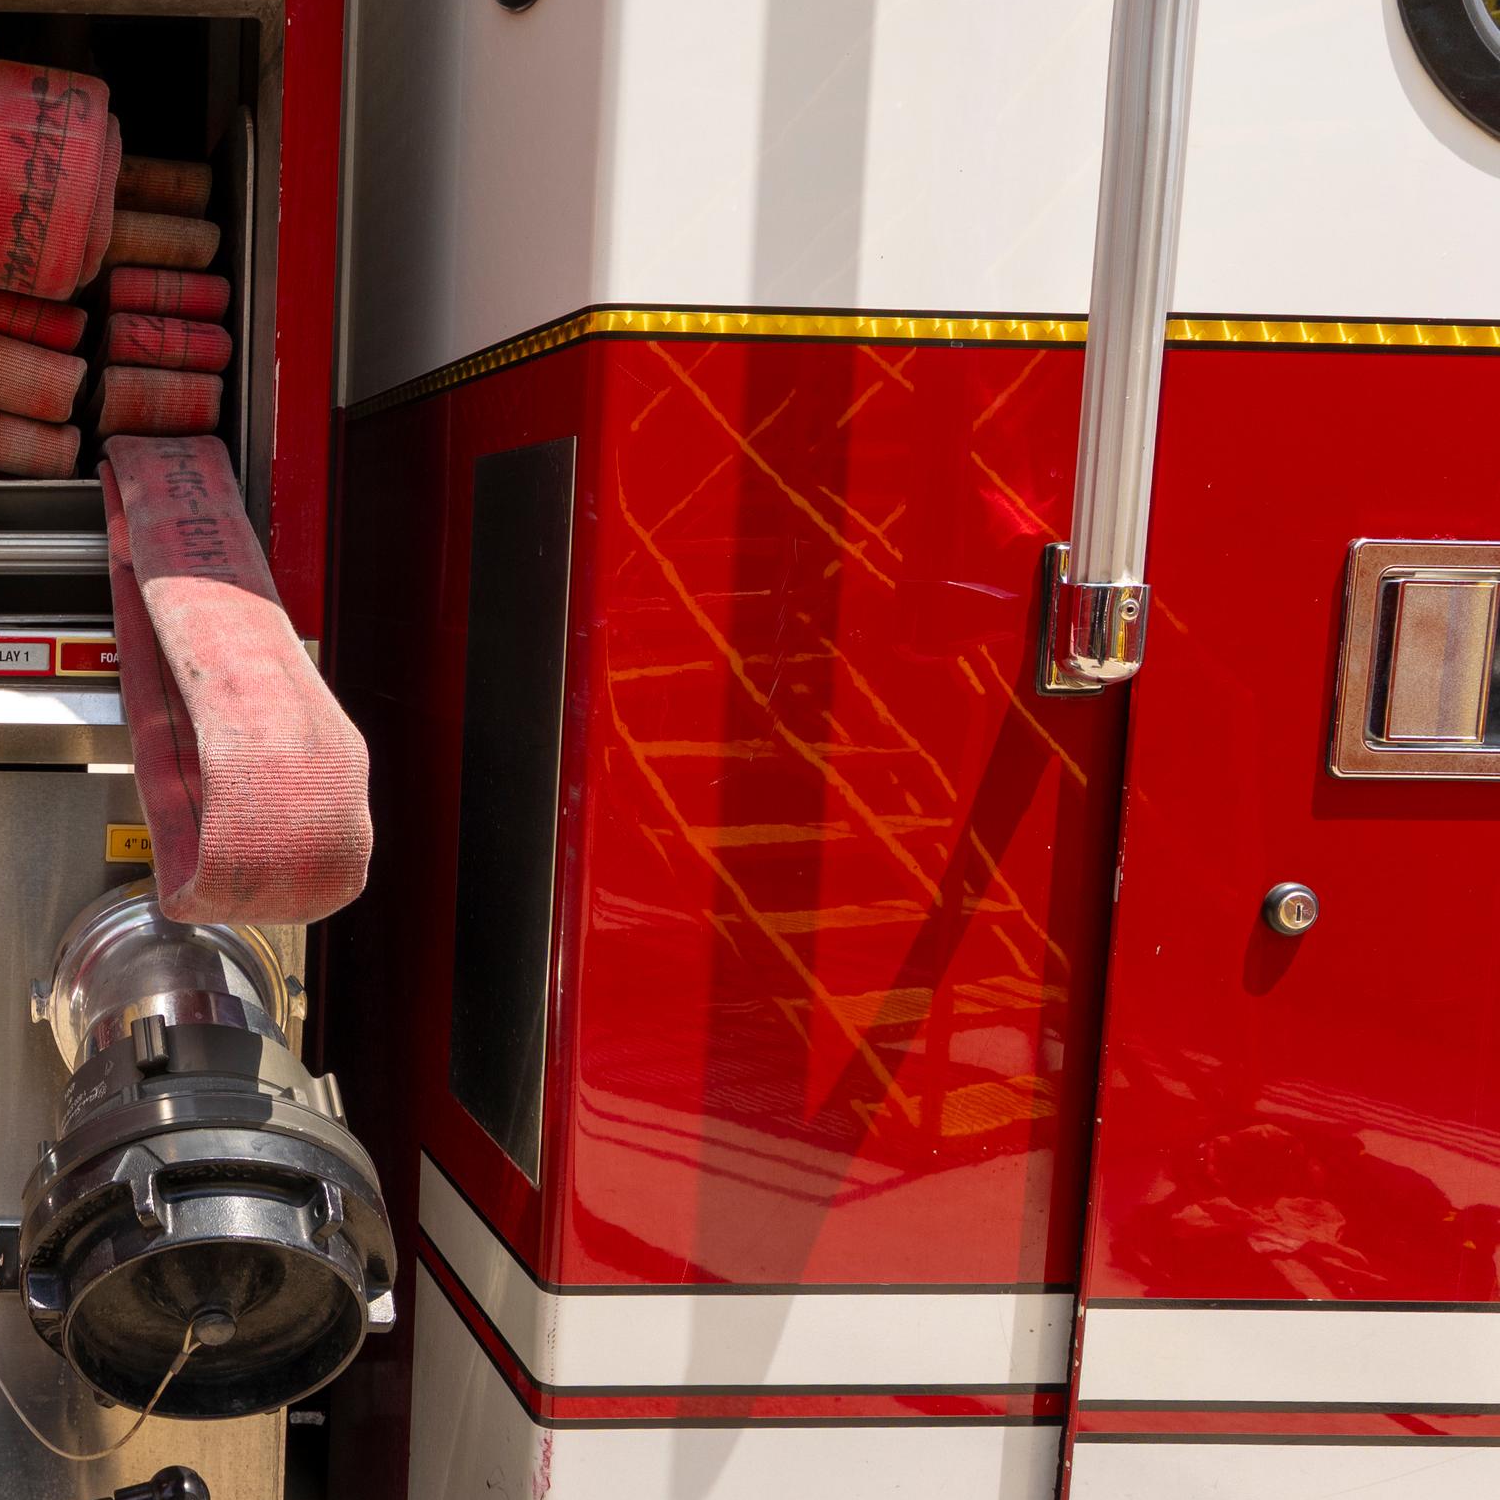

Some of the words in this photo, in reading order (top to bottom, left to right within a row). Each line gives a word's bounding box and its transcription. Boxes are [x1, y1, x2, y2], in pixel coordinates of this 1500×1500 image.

[25, 651, 30, 662] 1
[100, 652, 119, 663] FOA
[124, 838, 137, 850] 4"
